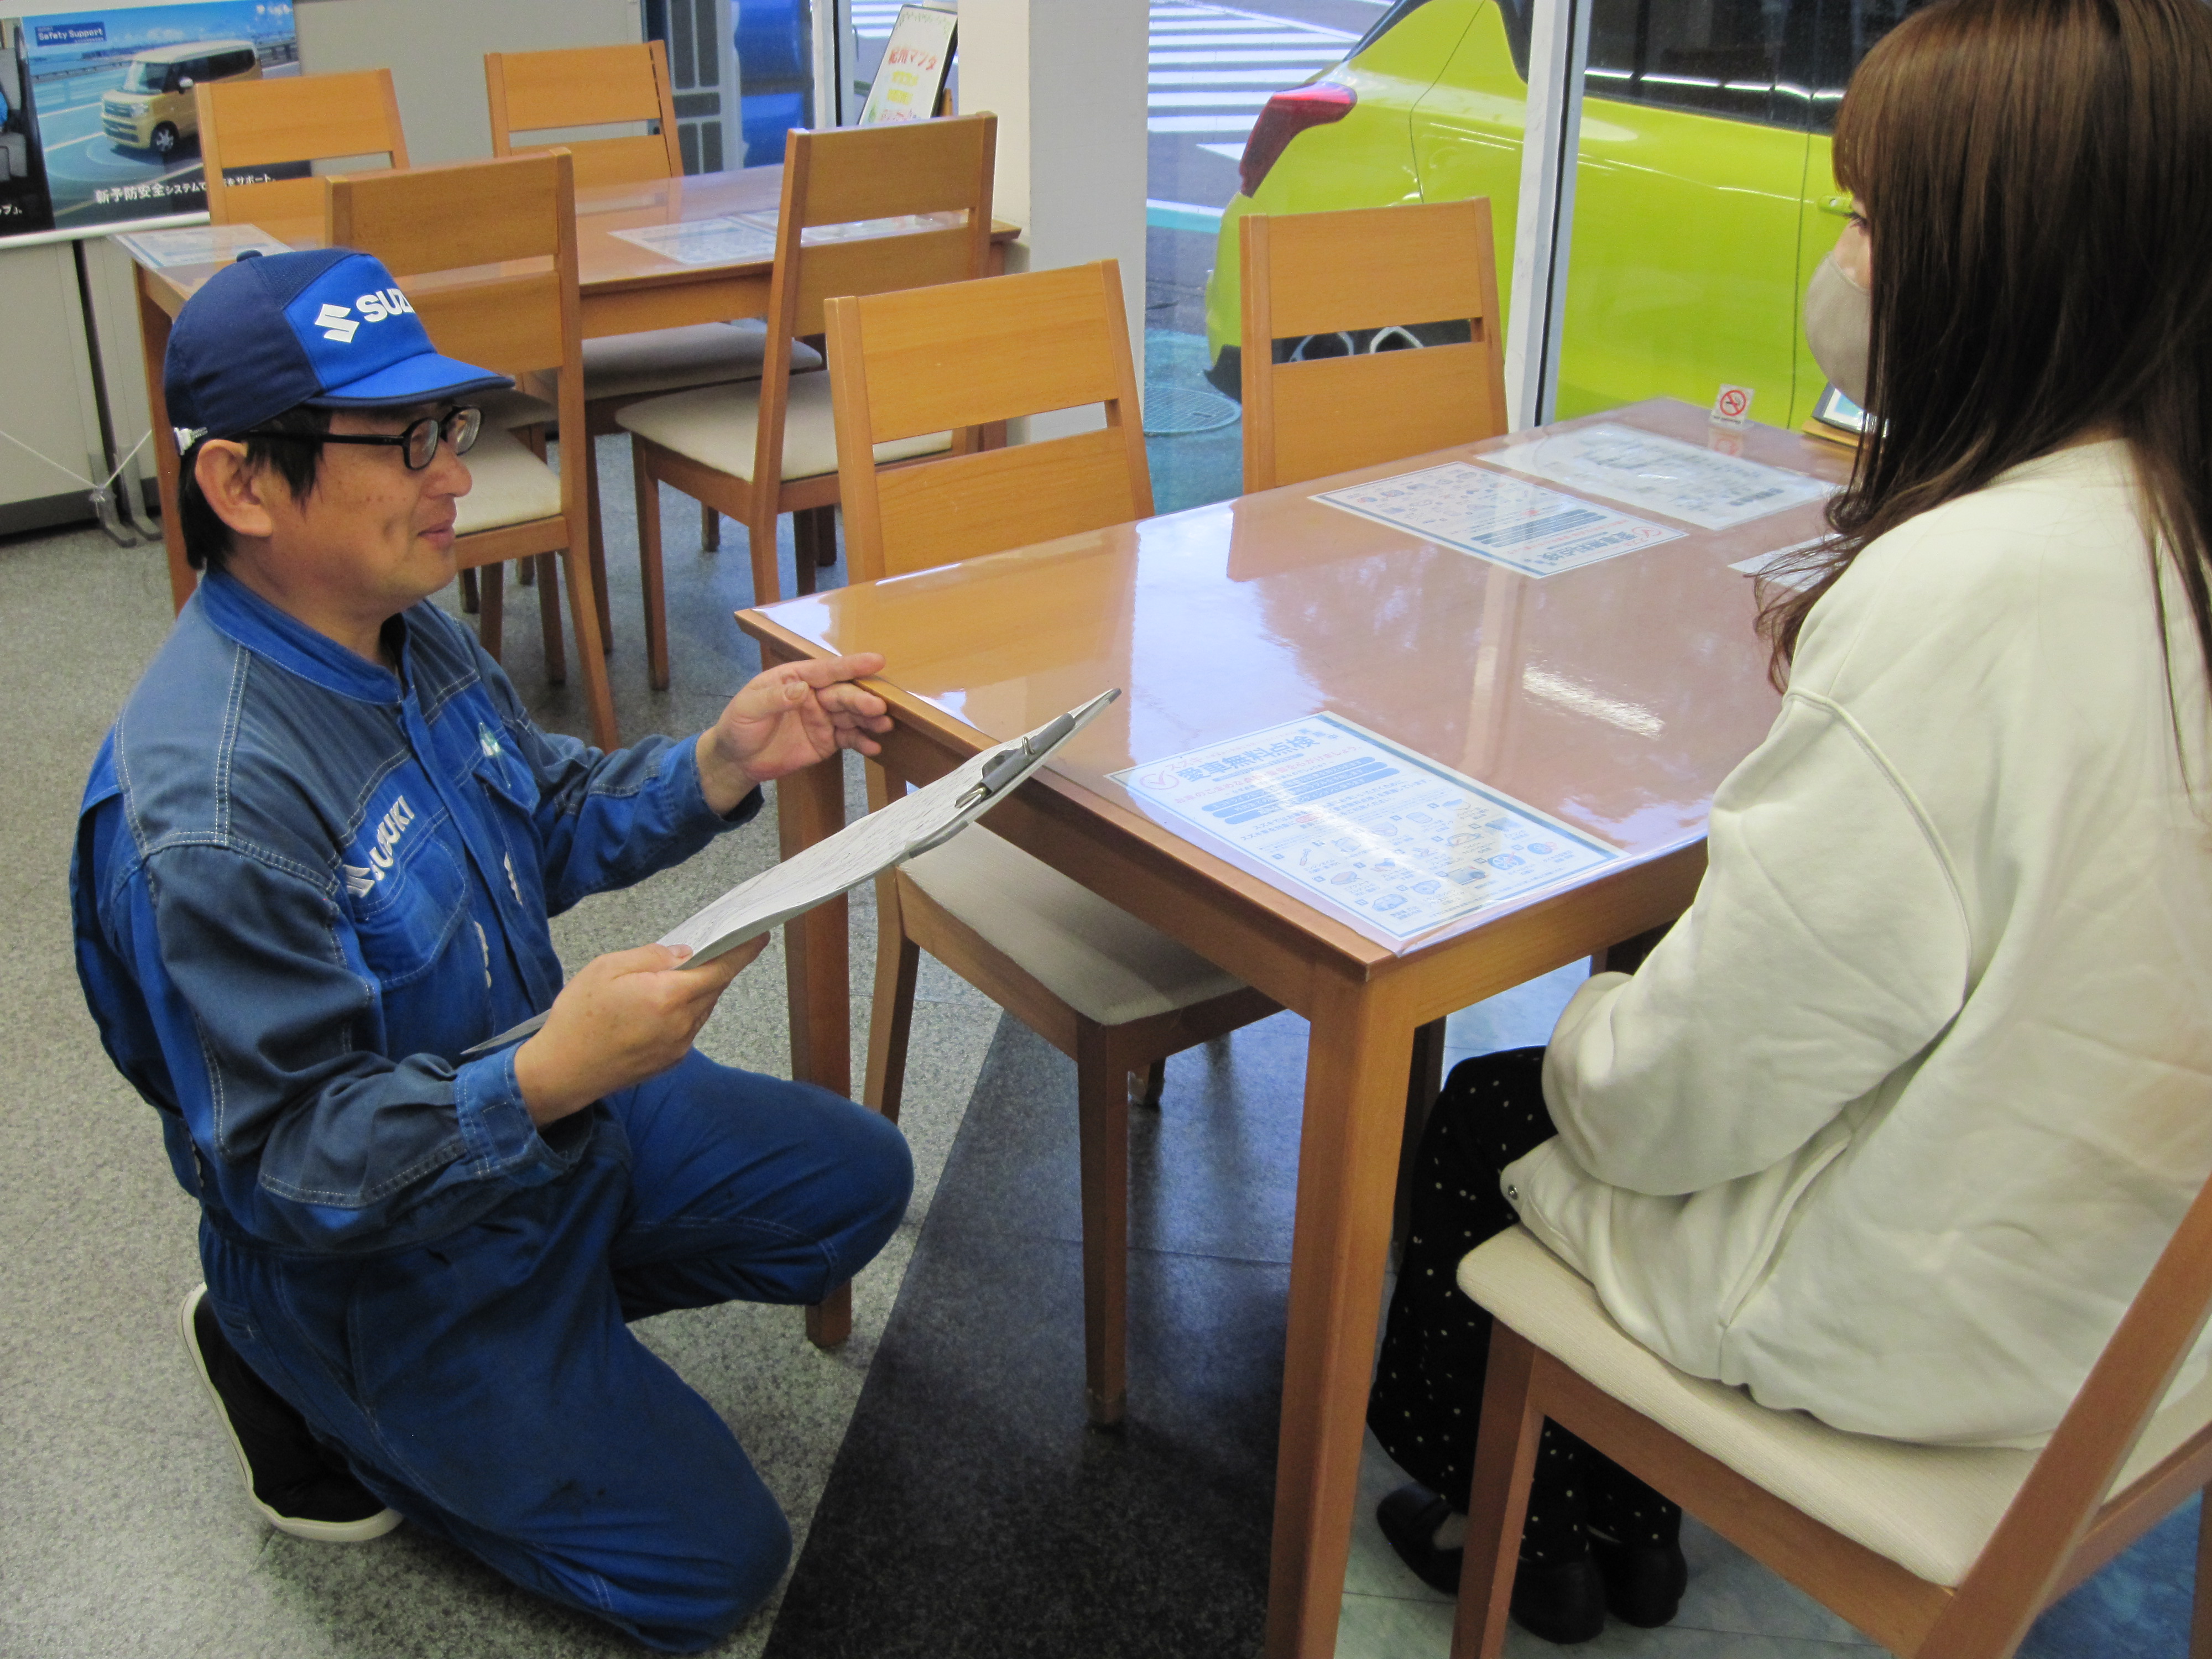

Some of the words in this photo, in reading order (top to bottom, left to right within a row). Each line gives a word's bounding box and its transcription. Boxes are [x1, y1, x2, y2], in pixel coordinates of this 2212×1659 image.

[38, 31, 67, 40] Safety
[68, 28, 103, 38] Support
[356, 288, 416, 322] SUZ
[1164, 757, 1203, 771] スズキ
[1175, 734, 1321, 782] 愛車無料点検
[369, 795, 415, 881] UZUKI
